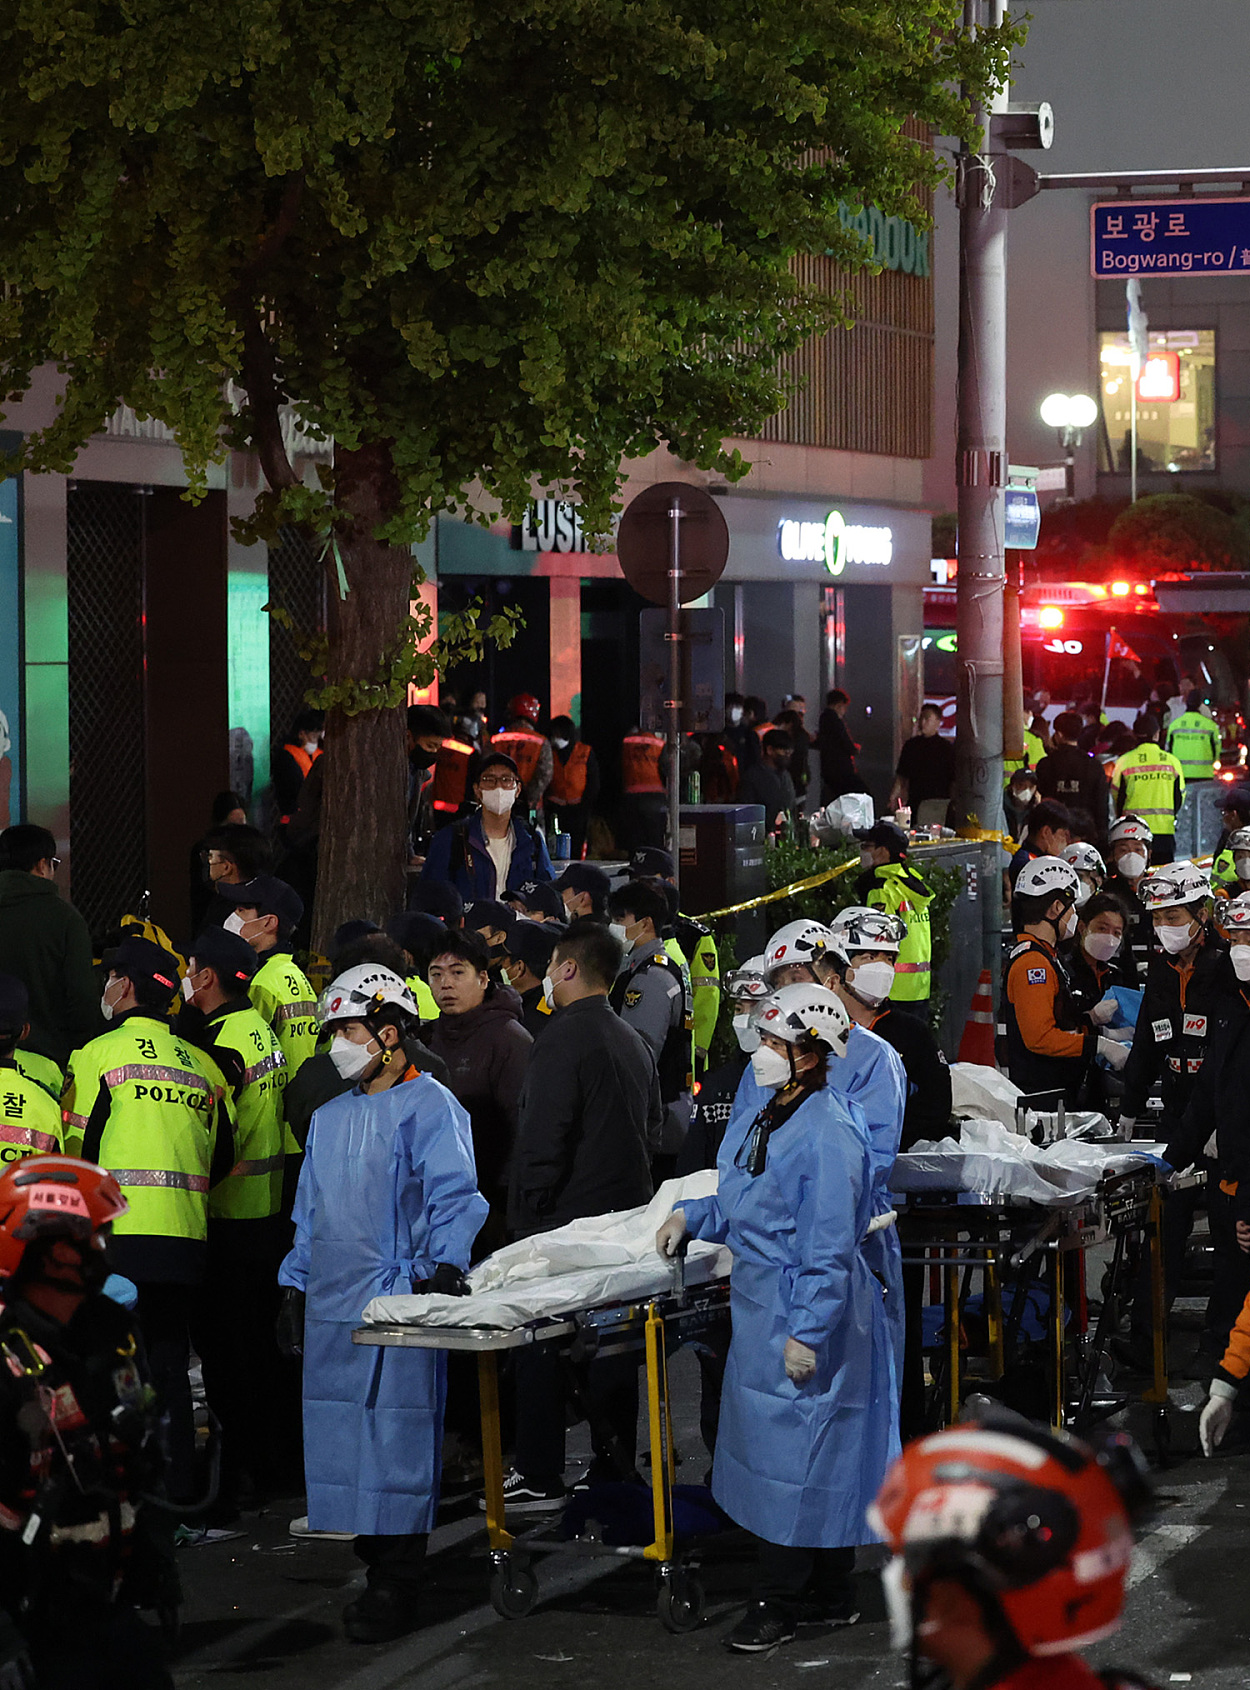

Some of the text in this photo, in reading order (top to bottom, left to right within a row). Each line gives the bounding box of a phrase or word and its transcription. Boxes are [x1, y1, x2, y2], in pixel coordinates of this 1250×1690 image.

[1102, 212, 1190, 242] 보광로
[1102, 250, 1224, 272] Bogwang-ro
[1186, 1018, 1206, 1030] 119
